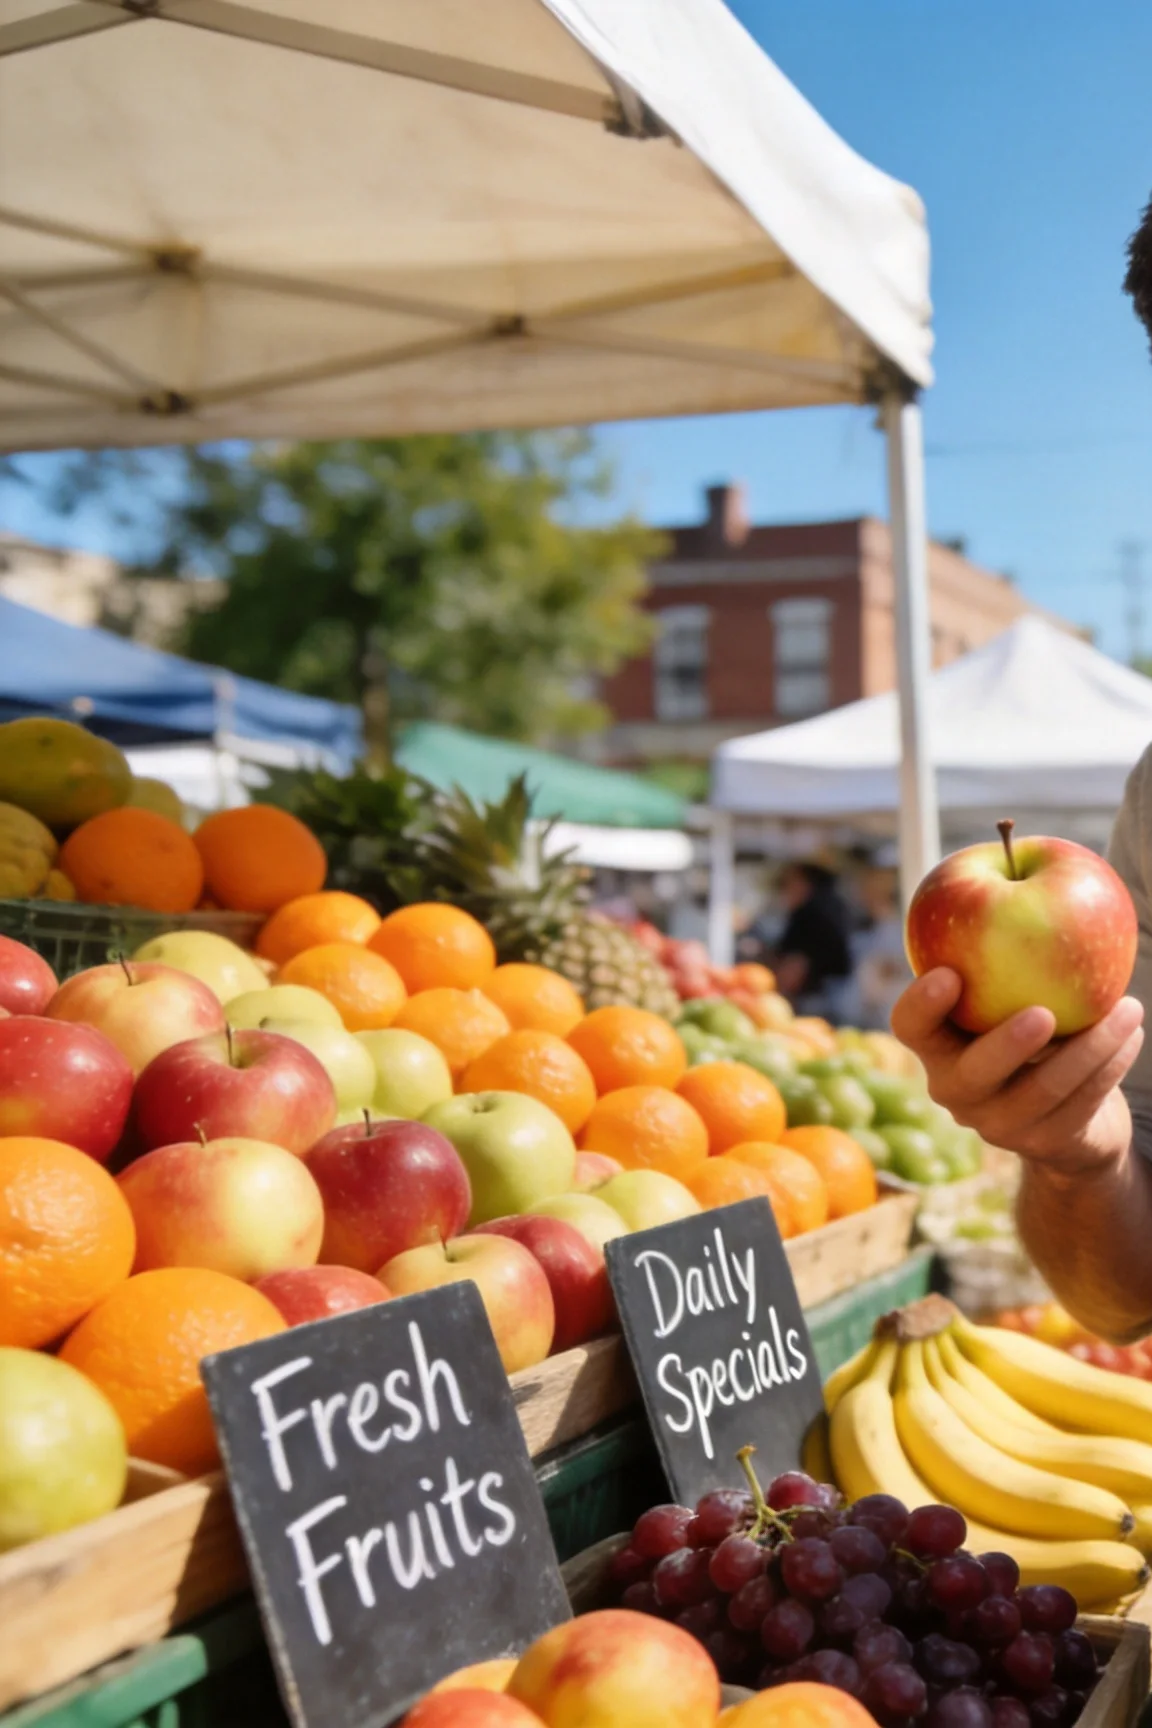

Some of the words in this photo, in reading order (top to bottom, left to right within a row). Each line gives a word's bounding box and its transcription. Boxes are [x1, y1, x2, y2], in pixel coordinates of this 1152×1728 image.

[635, 1228, 756, 1339] Daily
[252, 1321, 471, 1492] Fresh
[656, 1306, 808, 1459] Specials
[286, 1457, 516, 1646] Fruits
